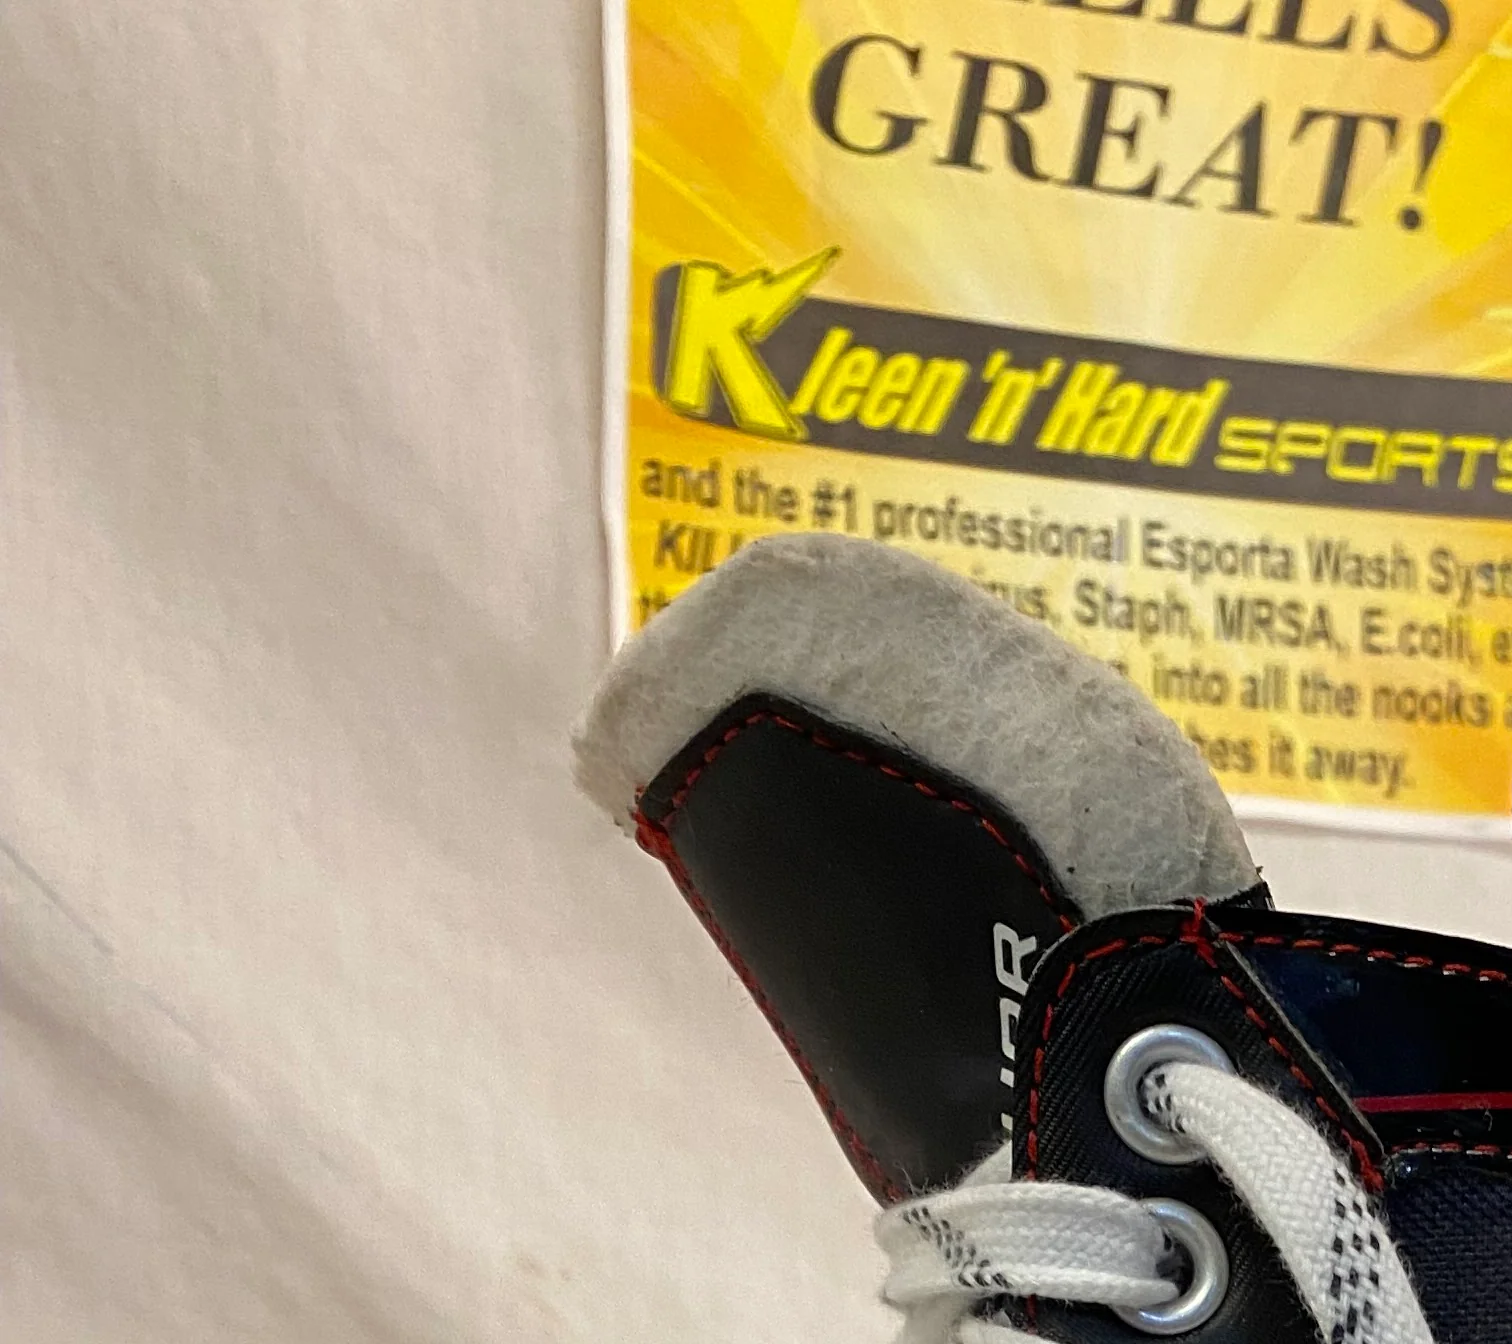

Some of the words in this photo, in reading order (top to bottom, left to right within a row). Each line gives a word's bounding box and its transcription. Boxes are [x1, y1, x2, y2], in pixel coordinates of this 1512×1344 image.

[807, 33, 1449, 231] GREAT!
[1035, 358, 1231, 468] Hard
[640, 457, 720, 508] and
[733, 464, 799, 522] the
[811, 479, 858, 532] #1
[873, 495, 1130, 565] professional
[1141, 519, 1295, 586] Esporta
[1305, 536, 1418, 593] Wash
[1213, 595, 1349, 657] MRSA,
[1153, 652, 1230, 706] into
[1239, 664, 1290, 714] all
[1297, 668, 1357, 720] the
[1371, 679, 1491, 728] nooks
[1268, 727, 1298, 774] it
